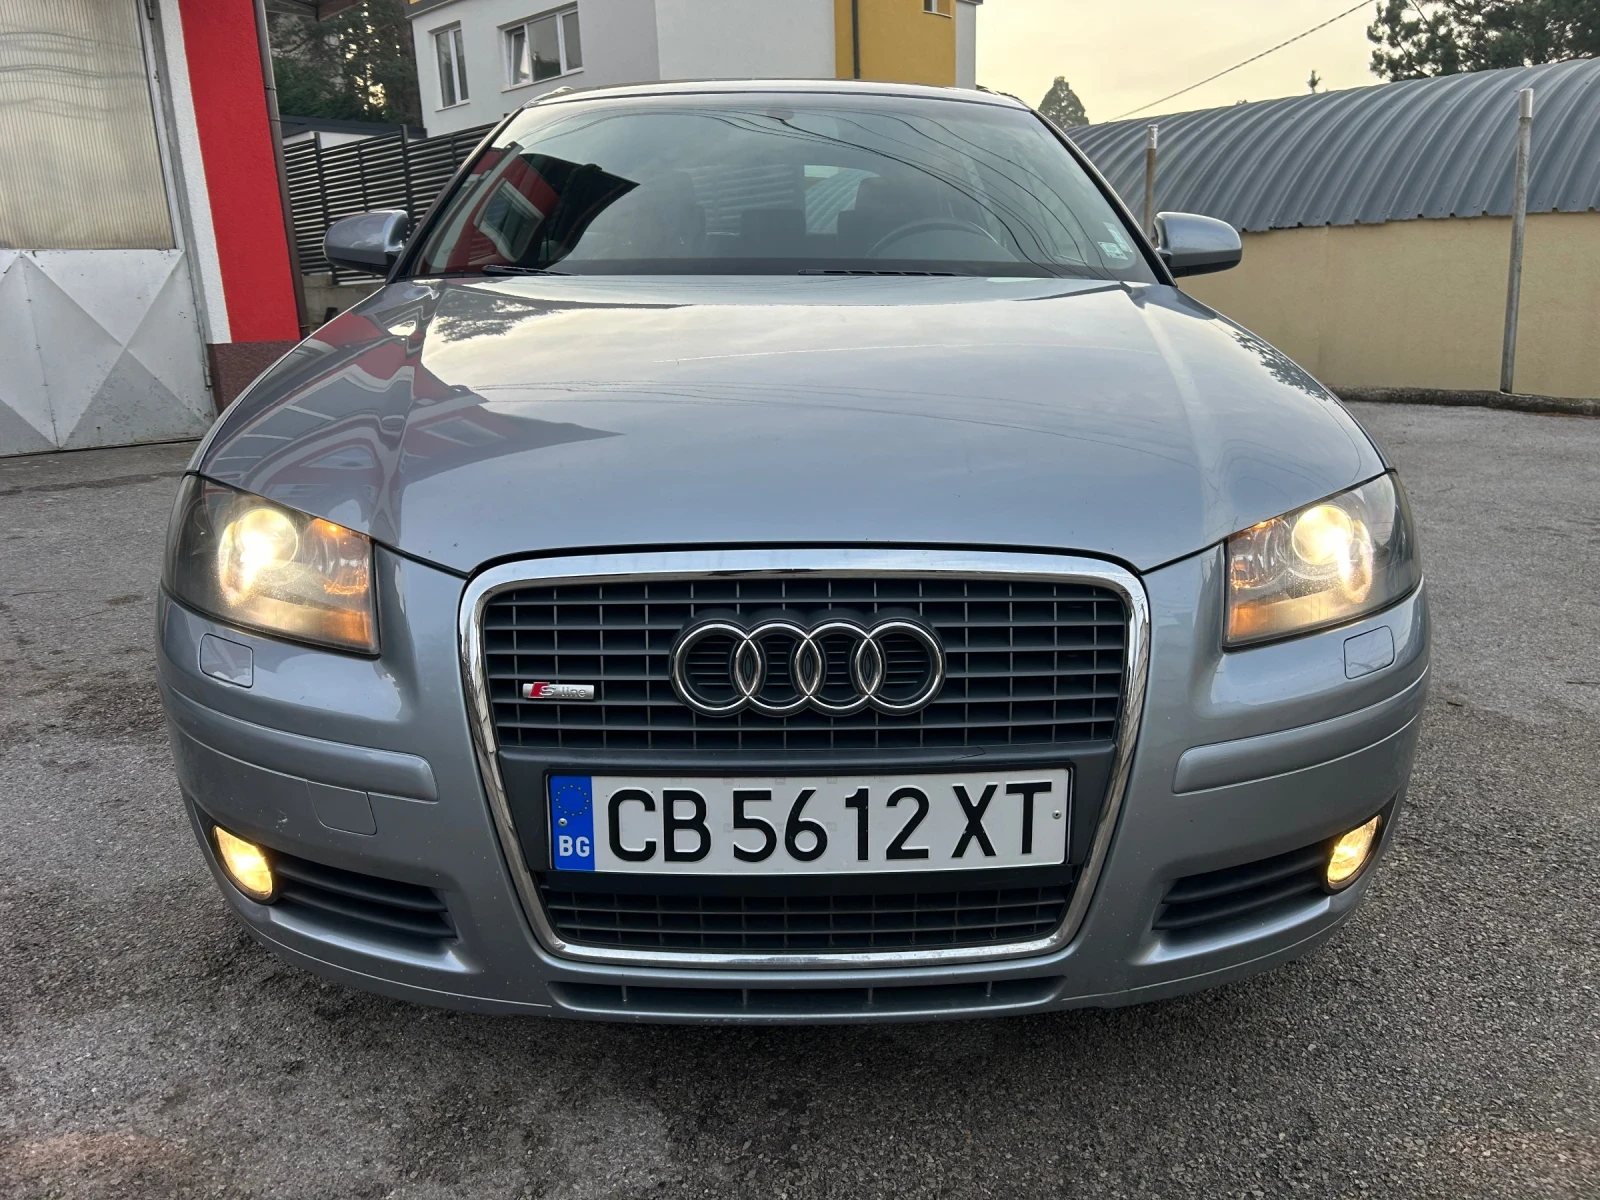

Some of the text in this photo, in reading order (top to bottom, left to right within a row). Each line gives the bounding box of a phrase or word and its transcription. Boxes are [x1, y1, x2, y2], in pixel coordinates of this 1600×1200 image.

[561, 686, 587, 698] line
[607, 781, 1053, 863] CB 5612 XT
[558, 835, 590, 857] BG
